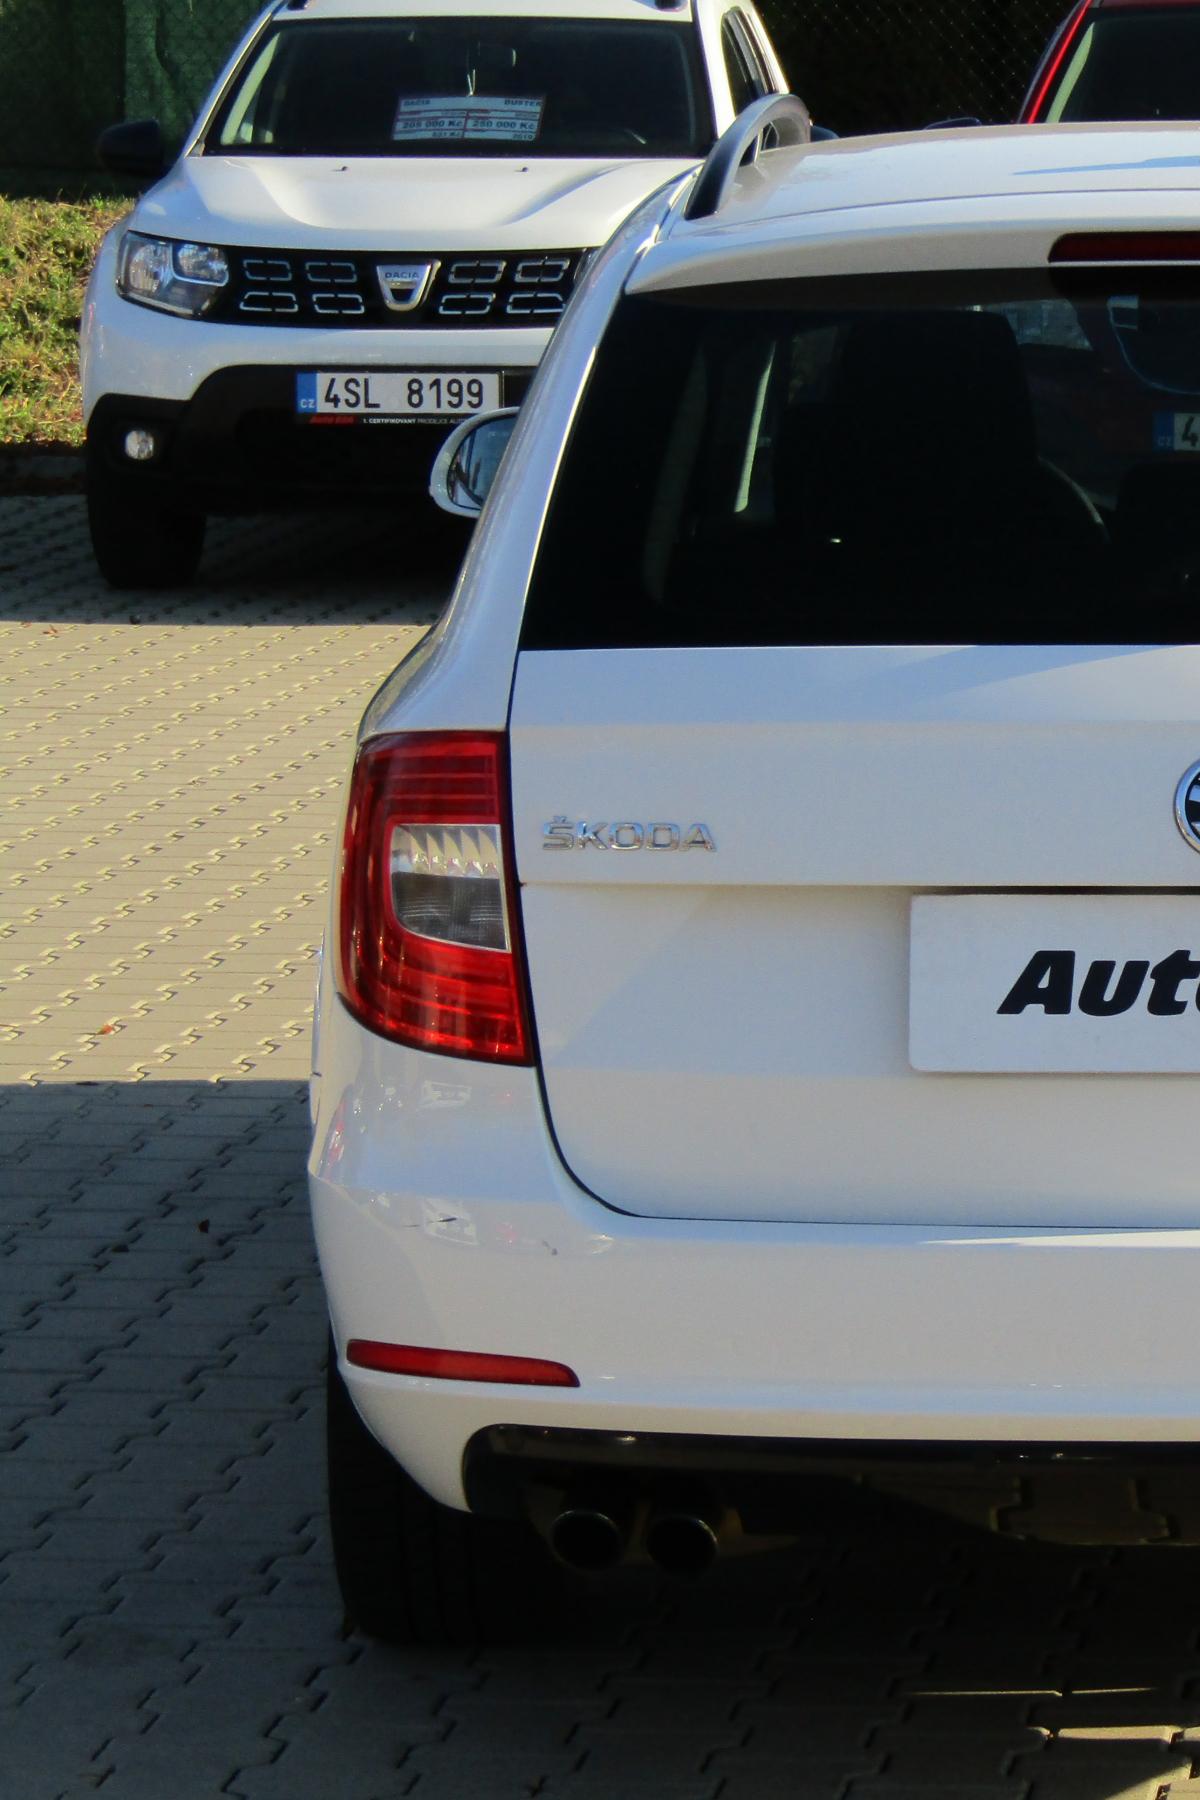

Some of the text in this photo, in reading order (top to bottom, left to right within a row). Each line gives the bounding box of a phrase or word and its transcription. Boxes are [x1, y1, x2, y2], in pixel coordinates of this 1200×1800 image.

[384, 271, 420, 280] DACIA
[300, 377, 484, 409] CZ 4SL 8199
[543, 815, 717, 852] ŠKODA
